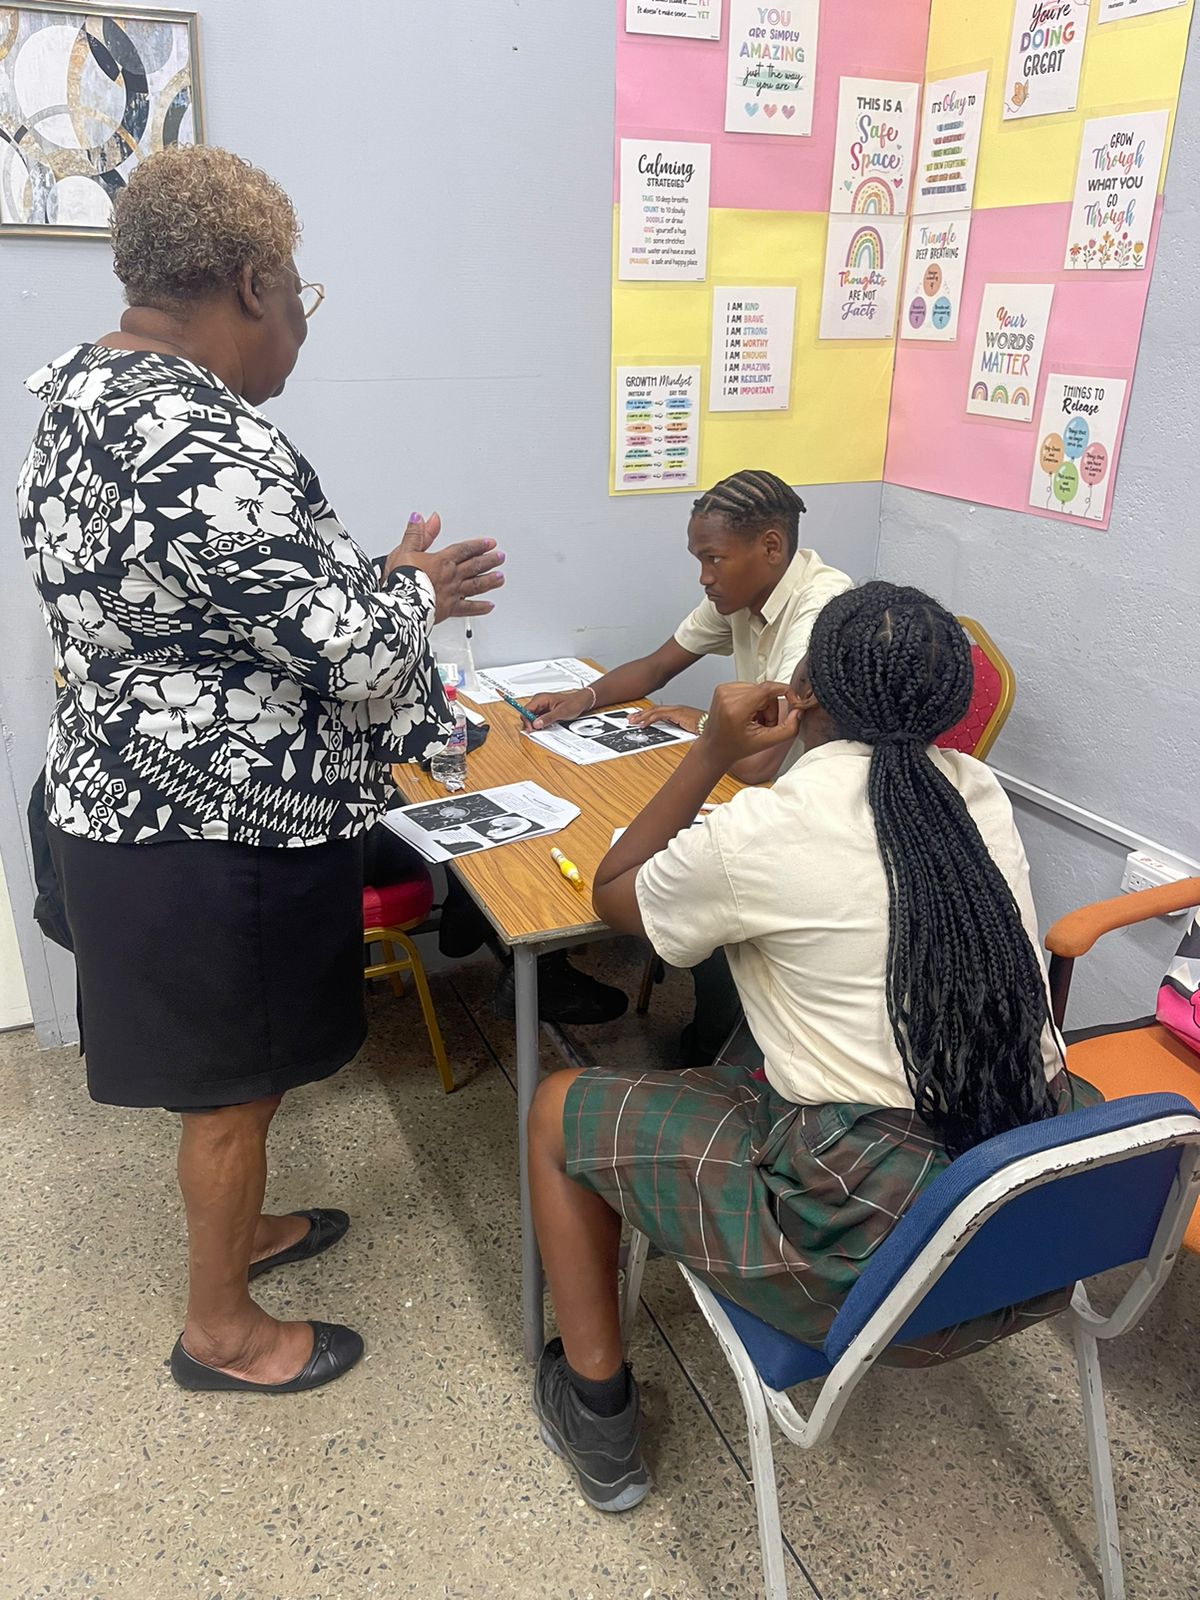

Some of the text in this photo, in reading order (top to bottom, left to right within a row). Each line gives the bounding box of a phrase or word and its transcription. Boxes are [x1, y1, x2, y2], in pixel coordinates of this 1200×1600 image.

[698, 10, 710, 19] YET
[757, 7, 791, 26] YOU
[1019, 21, 1075, 54] DOING
[740, 41, 805, 62] AMAZING
[1023, 49, 1066, 77] GREAT
[742, 62, 804, 88] just the way
[755, 81, 791, 97] you are
[857, 97, 902, 113] THIS IS A
[968, 95, 976, 106] TO
[858, 114, 899, 149] Safe
[1110, 132, 1135, 148] GROW
[850, 142, 901, 177] Space
[1092, 140, 1146, 175] Through
[638, 153, 696, 183] Calming
[646, 178, 685, 188] STRATEGIES
[1088, 176, 1143, 192] WHAT YOU
[1106, 193, 1119, 208] GO
[1084, 199, 1136, 233] Through
[916, 247, 959, 260] DEEP BREATHING
[838, 270, 887, 290] Thoughts
[848, 289, 876, 301] ARE NOT
[732, 302, 743, 311] AM
[731, 315, 742, 324] AM
[743, 315, 764, 323] BRAVE
[996, 306, 1028, 329] Your
[731, 327, 742, 336] AM
[742, 327, 768, 336] STRONG
[730, 339, 741, 348] AM
[742, 339, 769, 348] WORTHY
[985, 331, 1036, 352] WORDS
[729, 351, 740, 360] AM
[741, 351, 768, 360] ENOUGH
[728, 363, 740, 372] AM
[740, 363, 771, 372] AMAZING
[981, 351, 1031, 377] MATTER
[625, 373, 692, 388] GROWTH Mindset
[728, 375, 740, 384] AM
[740, 375, 772, 384] RESILIENT
[728, 386, 738, 395] AM
[739, 386, 775, 395] IMPORTANT
[1063, 385, 1105, 401] THINGS TO
[1062, 398, 1100, 416] Release
